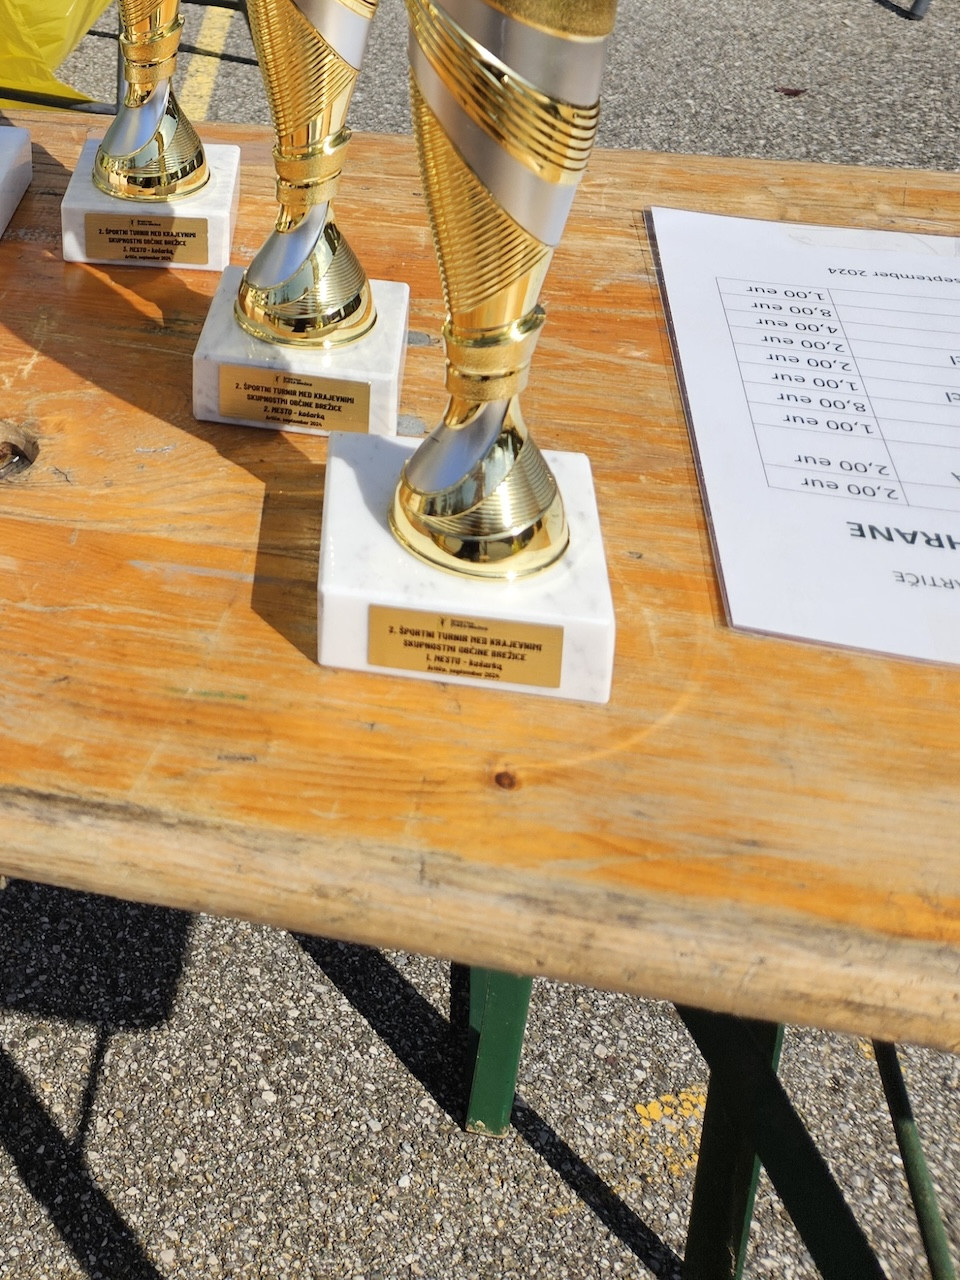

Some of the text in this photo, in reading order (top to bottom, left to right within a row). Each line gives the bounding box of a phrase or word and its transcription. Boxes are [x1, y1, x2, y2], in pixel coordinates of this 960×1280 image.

[828, 267, 867, 276] 2024
[746, 286, 825, 301] 1,00 eur
[751, 301, 831, 318] 8,00 eur
[756, 318, 838, 334] 4,00 eur
[761, 334, 845, 352] 2,00 eur
[766, 352, 852, 371] 2,00 eur
[244, 383, 271, 393] ŠPORTNI
[274, 387, 296, 396] TURNIR
[772, 372, 858, 391] 1,00 eur
[272, 407, 292, 415] MESTO
[290, 399, 313, 408] OBČINE
[315, 403, 342, 412] BREŽICE
[777, 392, 866, 412] 8,00 eur
[783, 414, 874, 434] 1,00 eur
[794, 455, 890, 476] 2,00 eur
[801, 478, 898, 500] 2,00 eur
[892, 570, 960, 589] RTIČE
